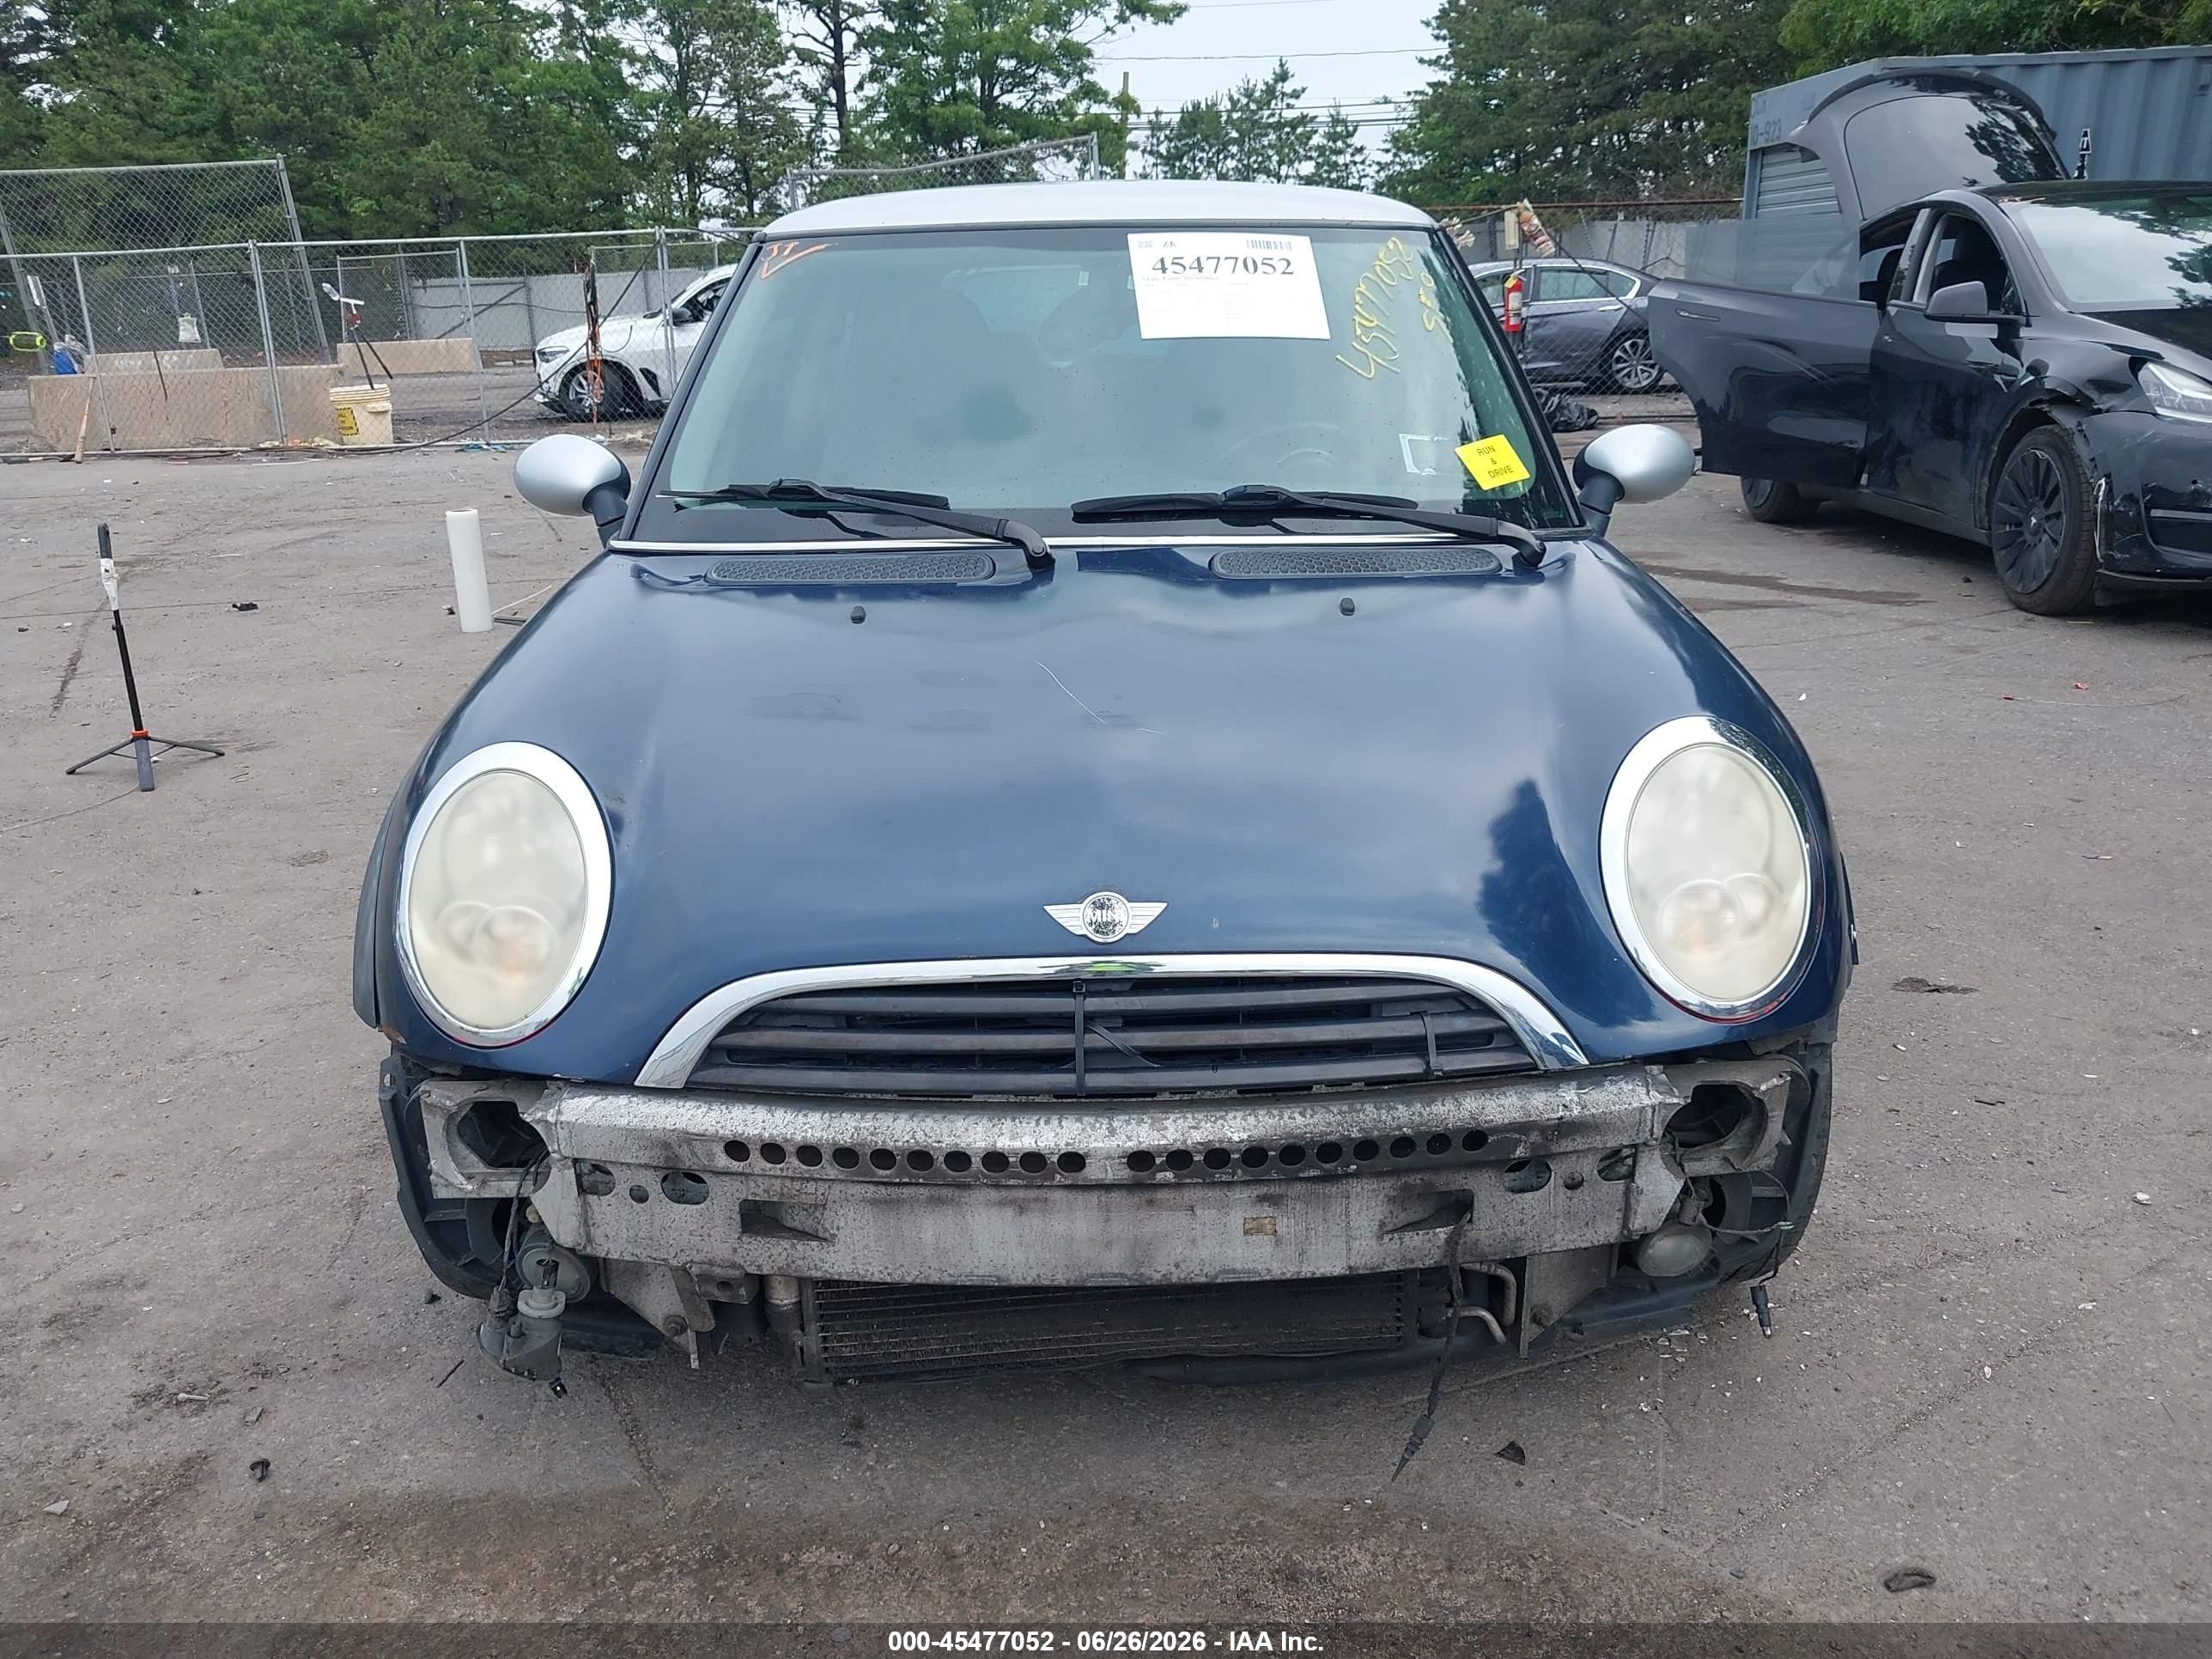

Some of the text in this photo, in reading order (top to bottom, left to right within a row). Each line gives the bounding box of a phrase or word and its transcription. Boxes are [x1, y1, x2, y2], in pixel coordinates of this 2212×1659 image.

[1152, 255, 1295, 276] 45477052
[1476, 445, 1497, 457] RUN
[1487, 465, 1515, 479] DRIVE
